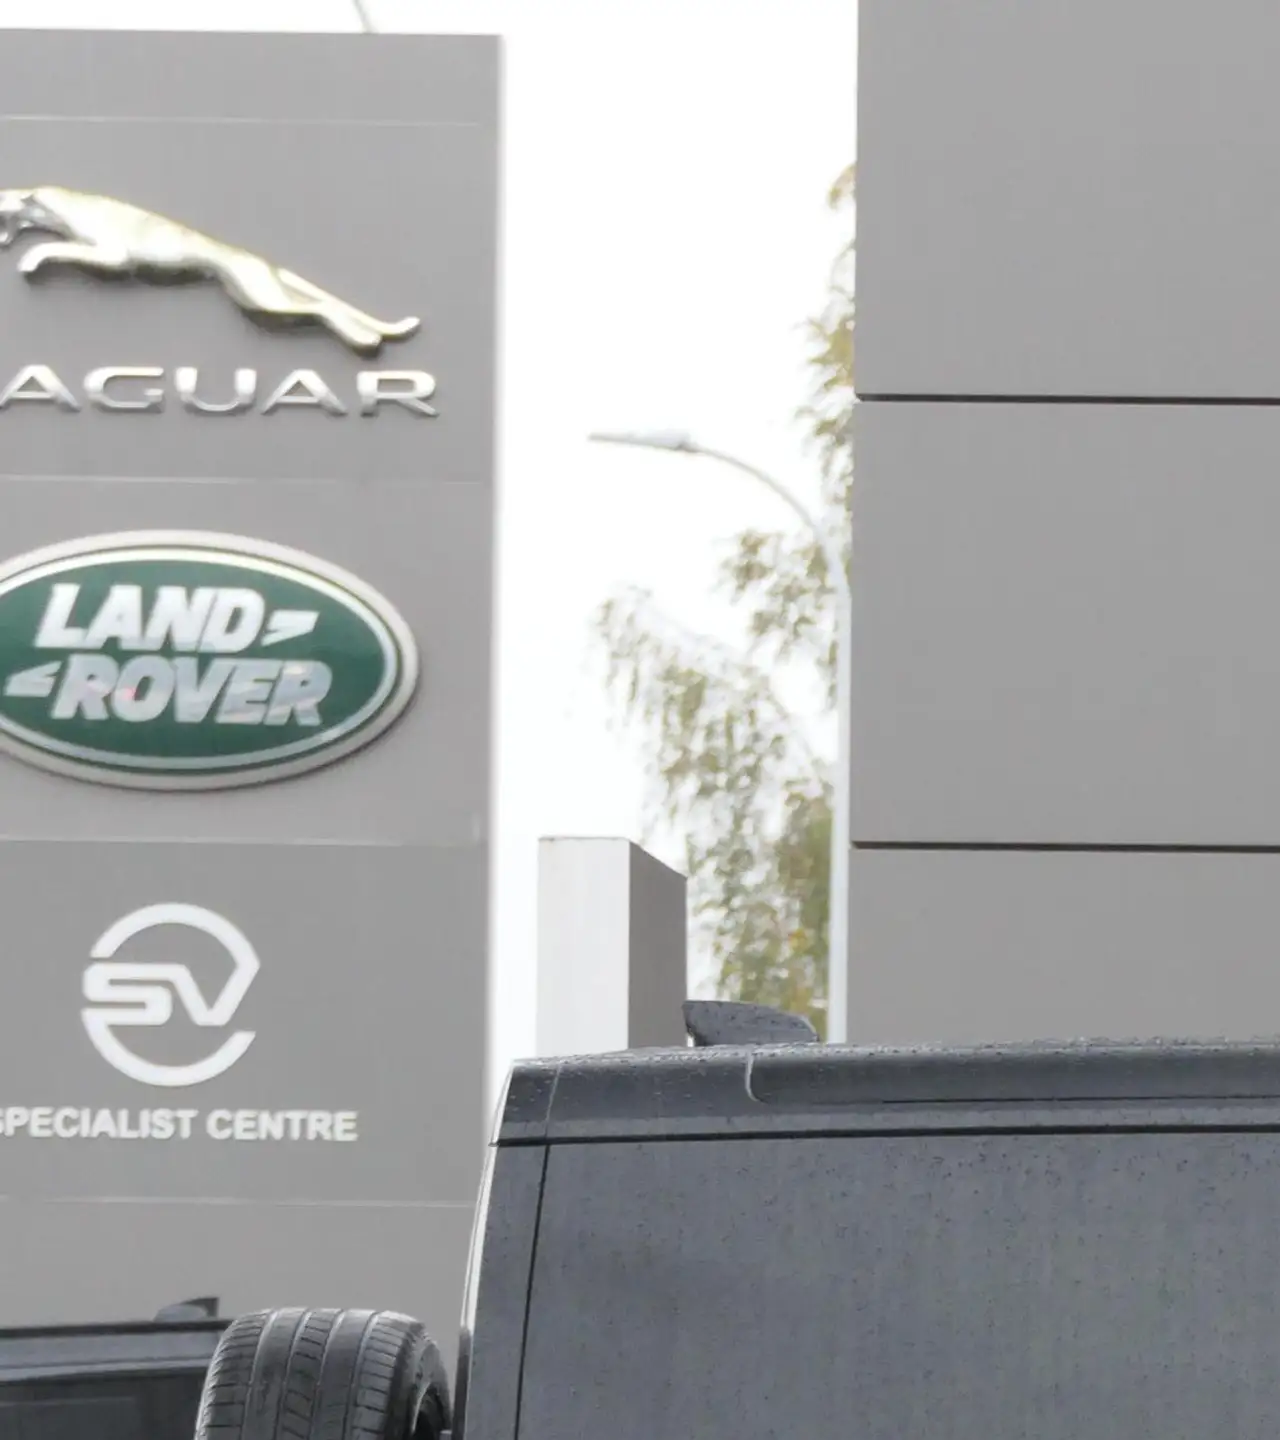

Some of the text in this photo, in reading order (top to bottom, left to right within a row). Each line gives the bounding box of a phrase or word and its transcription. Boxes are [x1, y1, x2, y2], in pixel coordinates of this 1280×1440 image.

[34, 582, 266, 653] LAND
[51, 653, 334, 726] ROVER
[0, 1106, 360, 1141] PECIALIST CENTRE
